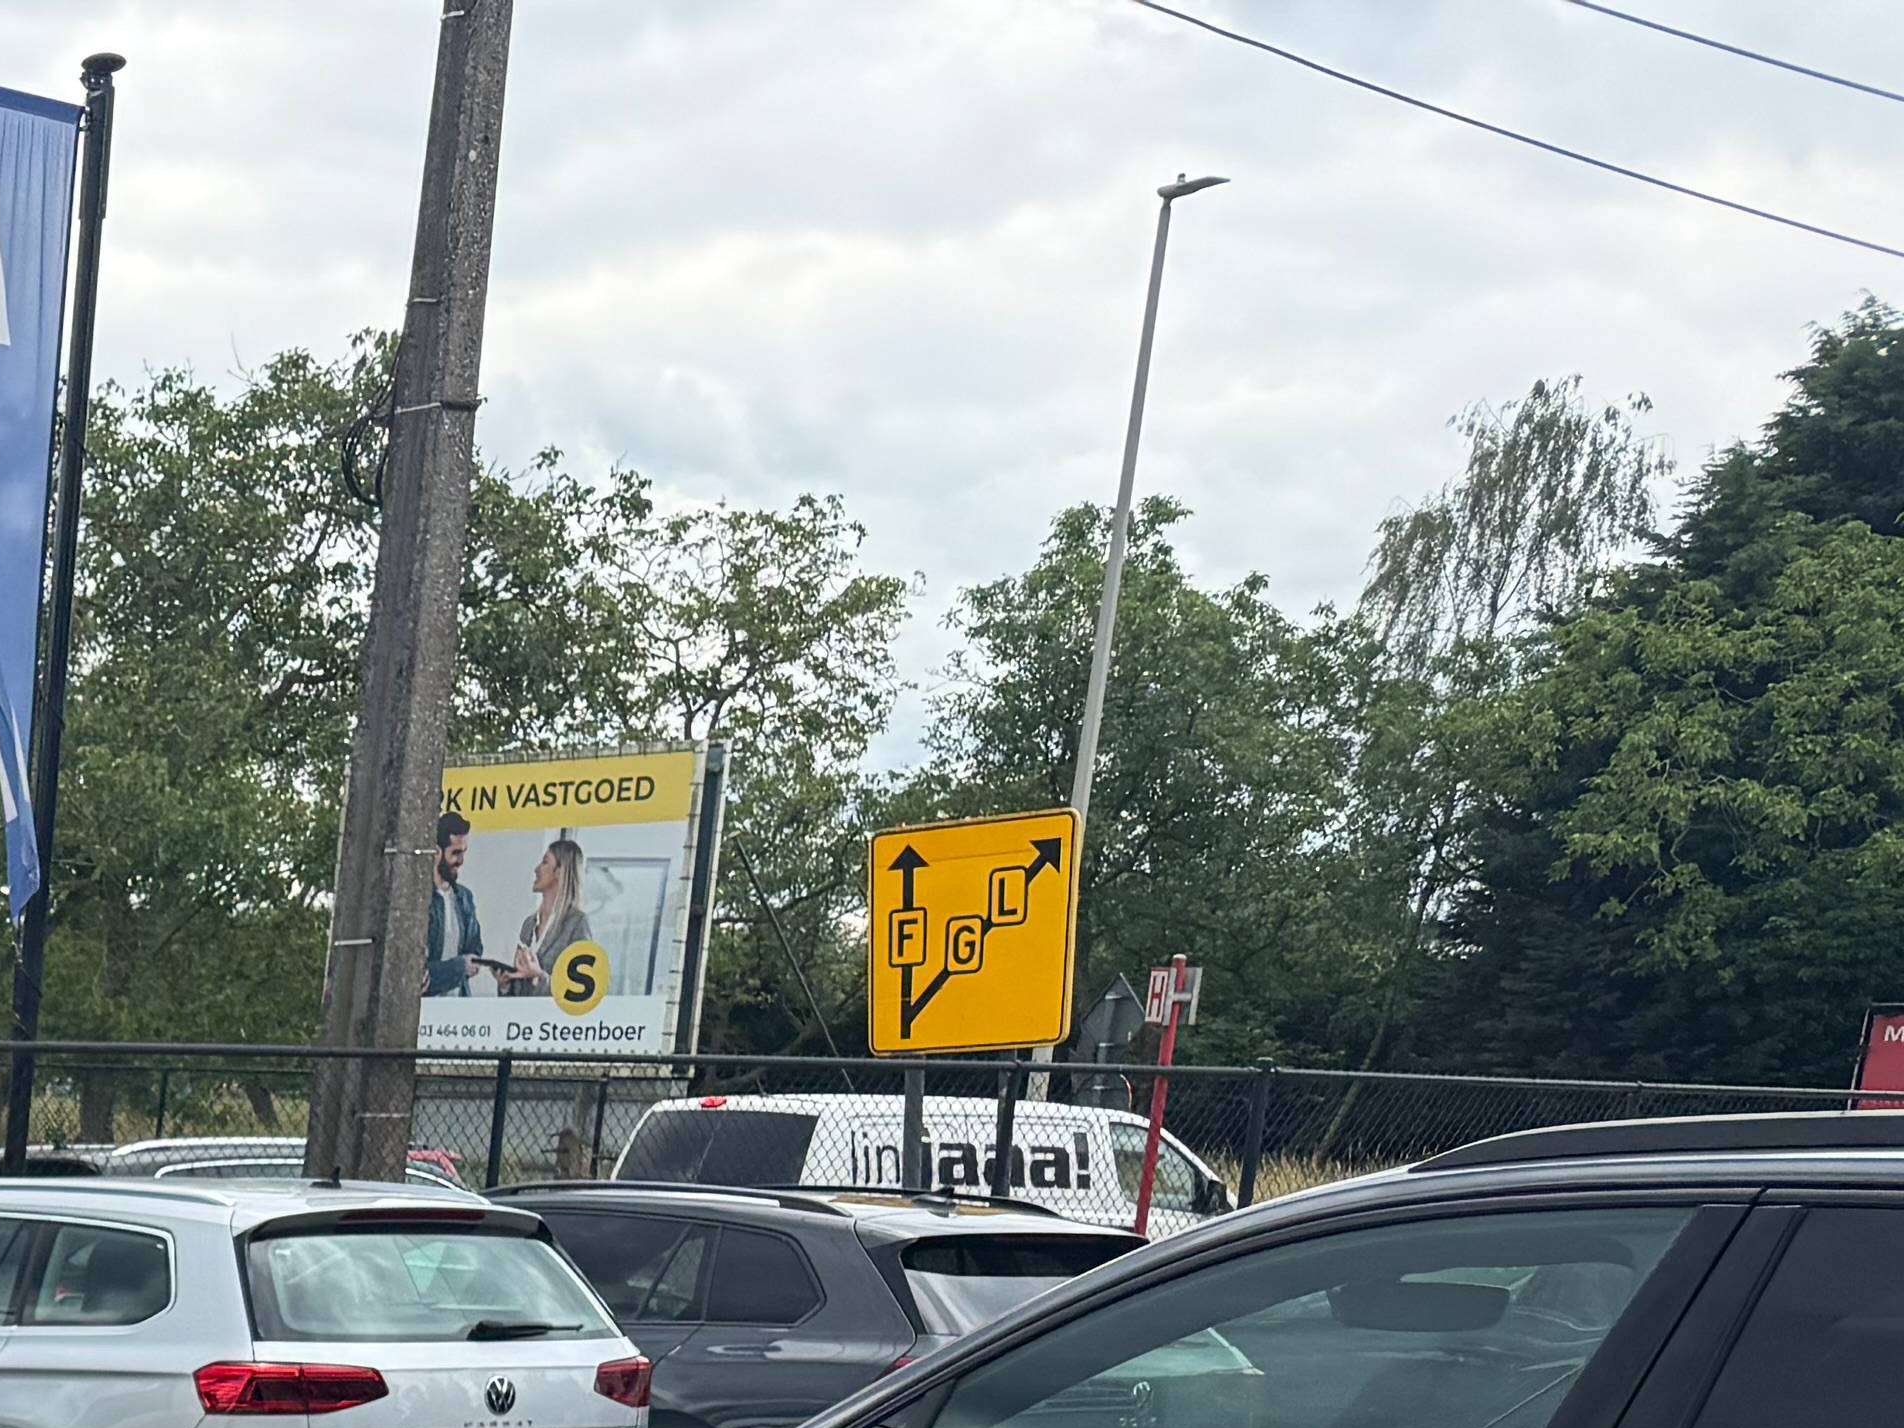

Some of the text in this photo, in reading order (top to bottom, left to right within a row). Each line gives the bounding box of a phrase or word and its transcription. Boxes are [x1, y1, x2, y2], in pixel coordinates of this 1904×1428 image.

[470, 785, 497, 811] IN
[506, 776, 655, 809] VASTGOED
[997, 878, 1018, 917] L
[897, 918, 918, 957] F
[953, 925, 976, 964] G
[479, 1025, 491, 1037] 01
[506, 1021, 646, 1042] De Steenboer
